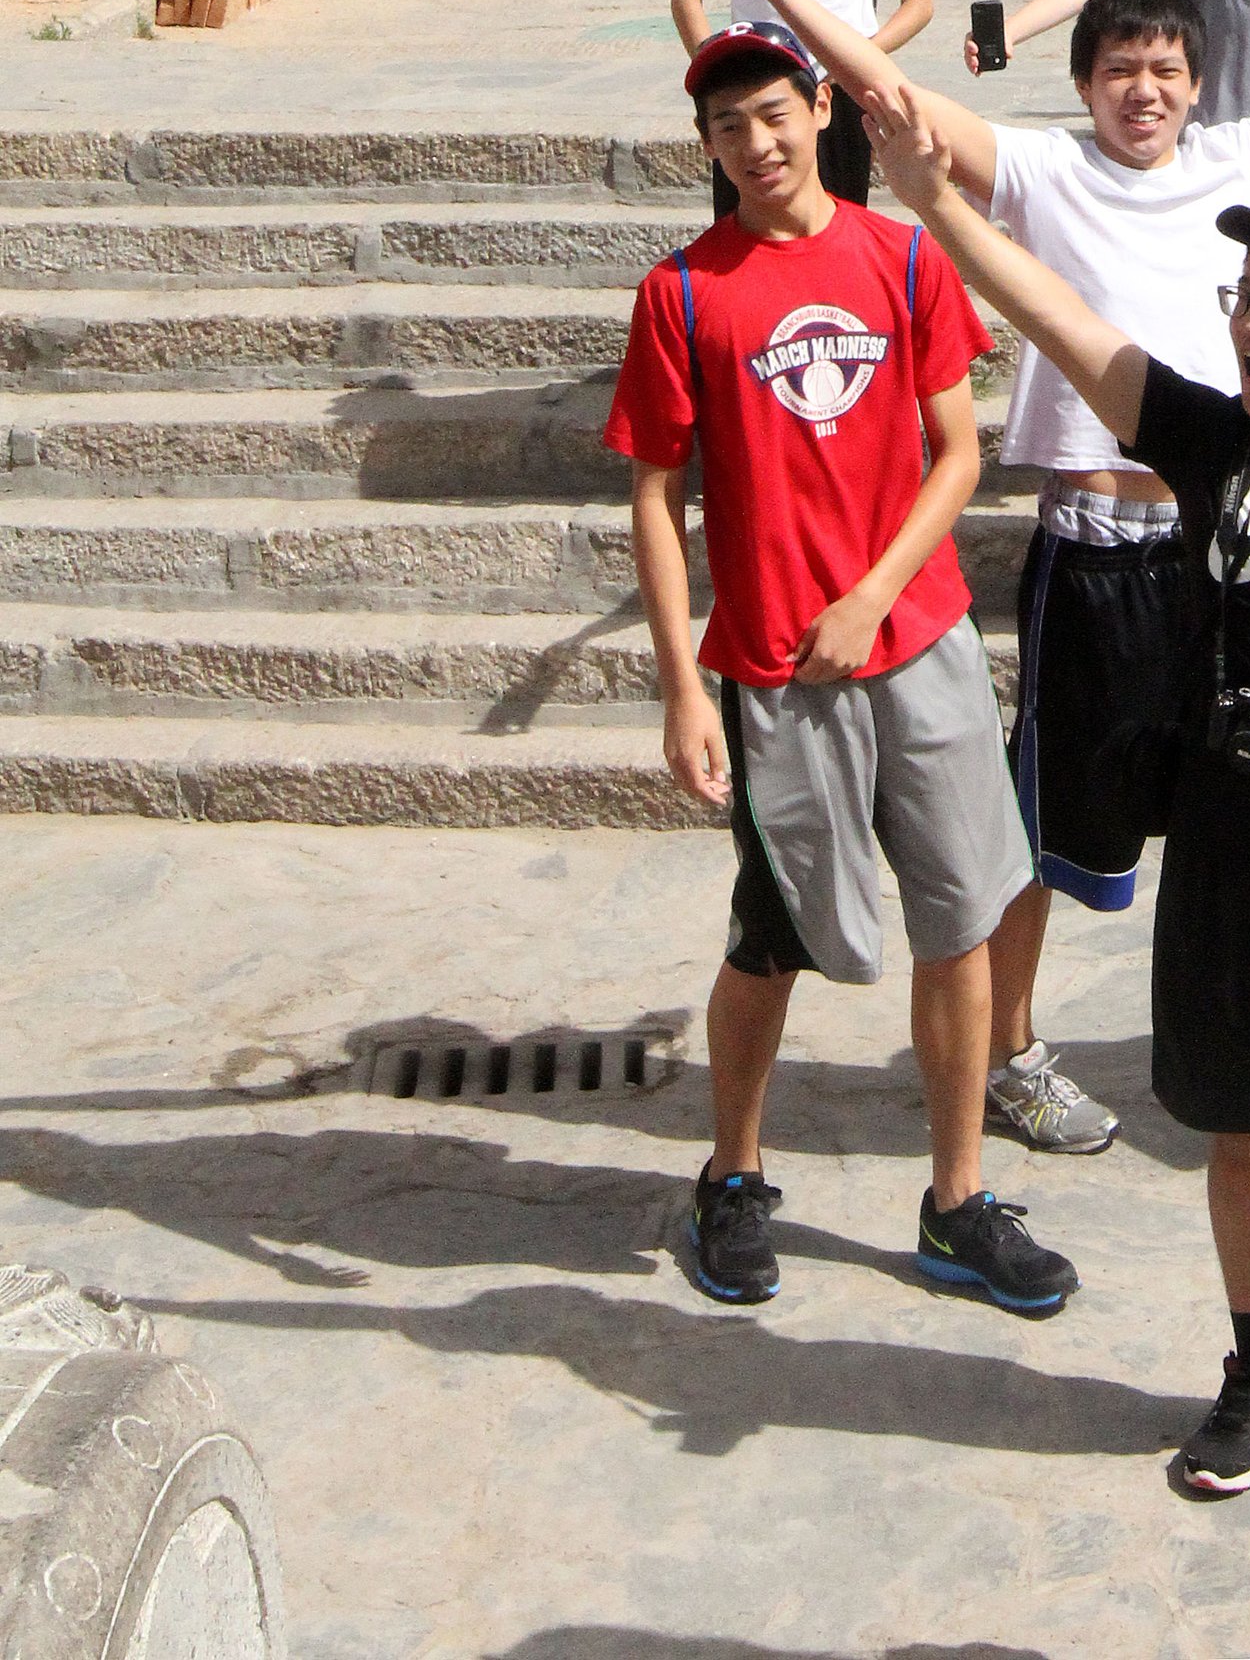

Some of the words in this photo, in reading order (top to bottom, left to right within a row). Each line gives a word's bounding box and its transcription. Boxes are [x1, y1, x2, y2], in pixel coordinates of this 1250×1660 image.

[751, 339, 810, 381] MARCH
[811, 335, 888, 362] MADNESS
[829, 370, 870, 414] CHAMPIONS
[1224, 475, 1240, 514] Nikon
